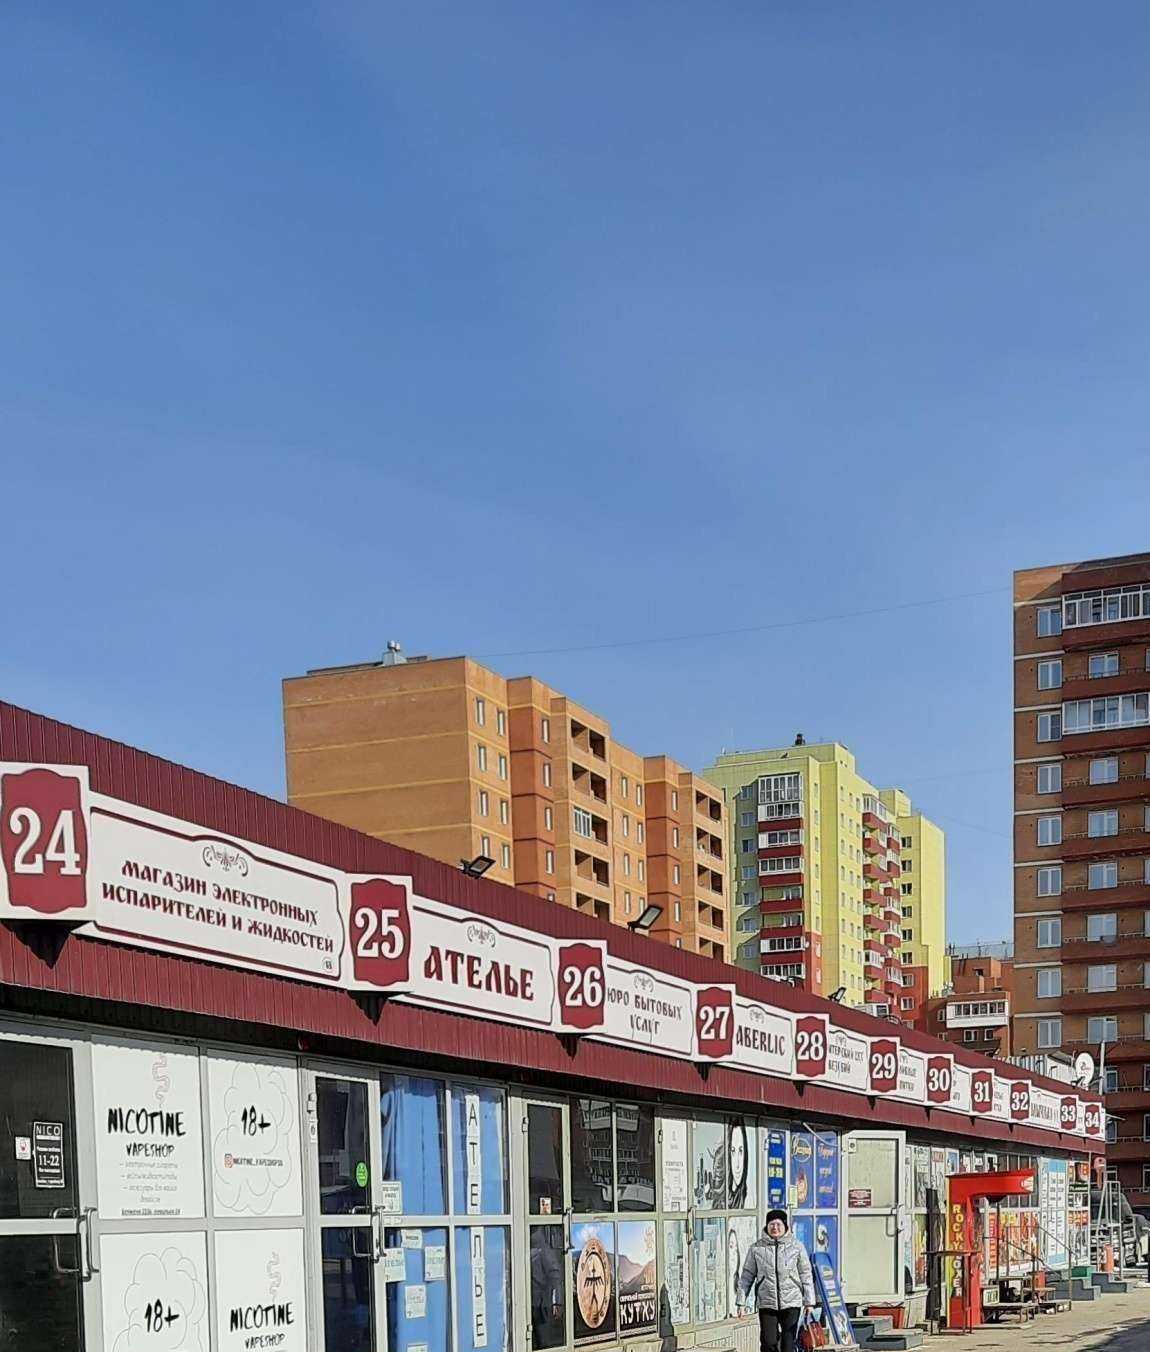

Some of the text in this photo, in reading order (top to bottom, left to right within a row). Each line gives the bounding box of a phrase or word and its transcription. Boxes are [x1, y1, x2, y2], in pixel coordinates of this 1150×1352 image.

[9, 806, 82, 876] 24
[121, 860, 318, 928] МАГАЗИН ЭЛЕКТРОННЫХ
[102, 882, 334, 953] ИСПАРИТЕЛЕЙ И ЖИДКОСТЕЙ
[354, 907, 405, 960] 25
[423, 945, 535, 1001] АТЕЛЬЕ
[563, 965, 603, 1008] 26
[607, 987, 683, 1020] ЮРО БЫТОВЫХ
[629, 1013, 661, 1044] УСЛУГ
[699, 1005, 730, 1040] 27
[736, 1025, 785, 1057] ABERLIC
[796, 1030, 824, 1061] 28
[871, 1053, 896, 1079] 29
[928, 1068, 950, 1091] 30
[974, 1081, 991, 1103] 31
[1011, 1091, 1029, 1111] 32
[107, 1107, 187, 1137] NICOTINE
[241, 1104, 271, 1136] 18+
[1061, 1104, 1076, 1122] 33
[1085, 1111, 1100, 1128] 34
[36, 1124, 61, 1136] NICO
[38, 1154, 60, 1167] 11-22
[125, 1141, 175, 1158] VAPESHOP
[952, 1203, 964, 1250] ROCKY
[144, 1298, 180, 1333] 18+
[229, 1302, 295, 1333] NICOTINE
[619, 1299, 656, 1325] КУТХУ
[244, 1333, 286, 1350] VAPESHOP
